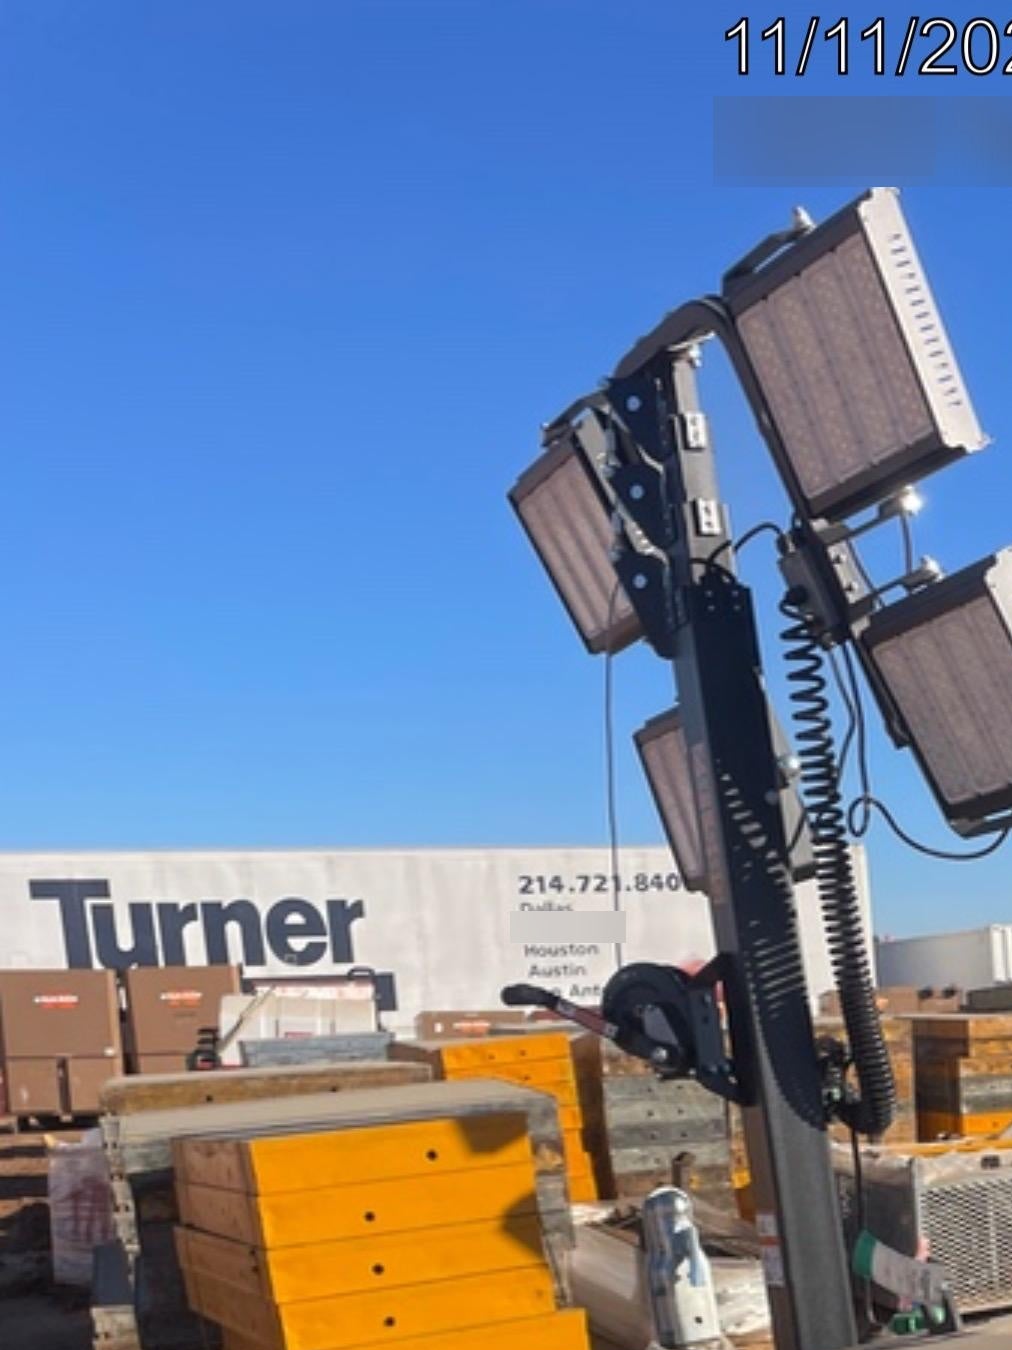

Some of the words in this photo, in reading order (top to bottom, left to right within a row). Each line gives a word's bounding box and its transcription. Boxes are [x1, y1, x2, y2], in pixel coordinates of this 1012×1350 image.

[519, 873, 683, 894] 214.721.840
[29, 879, 365, 968] Turner
[524, 943, 600, 958] Houston
[529, 963, 587, 978] Austin
